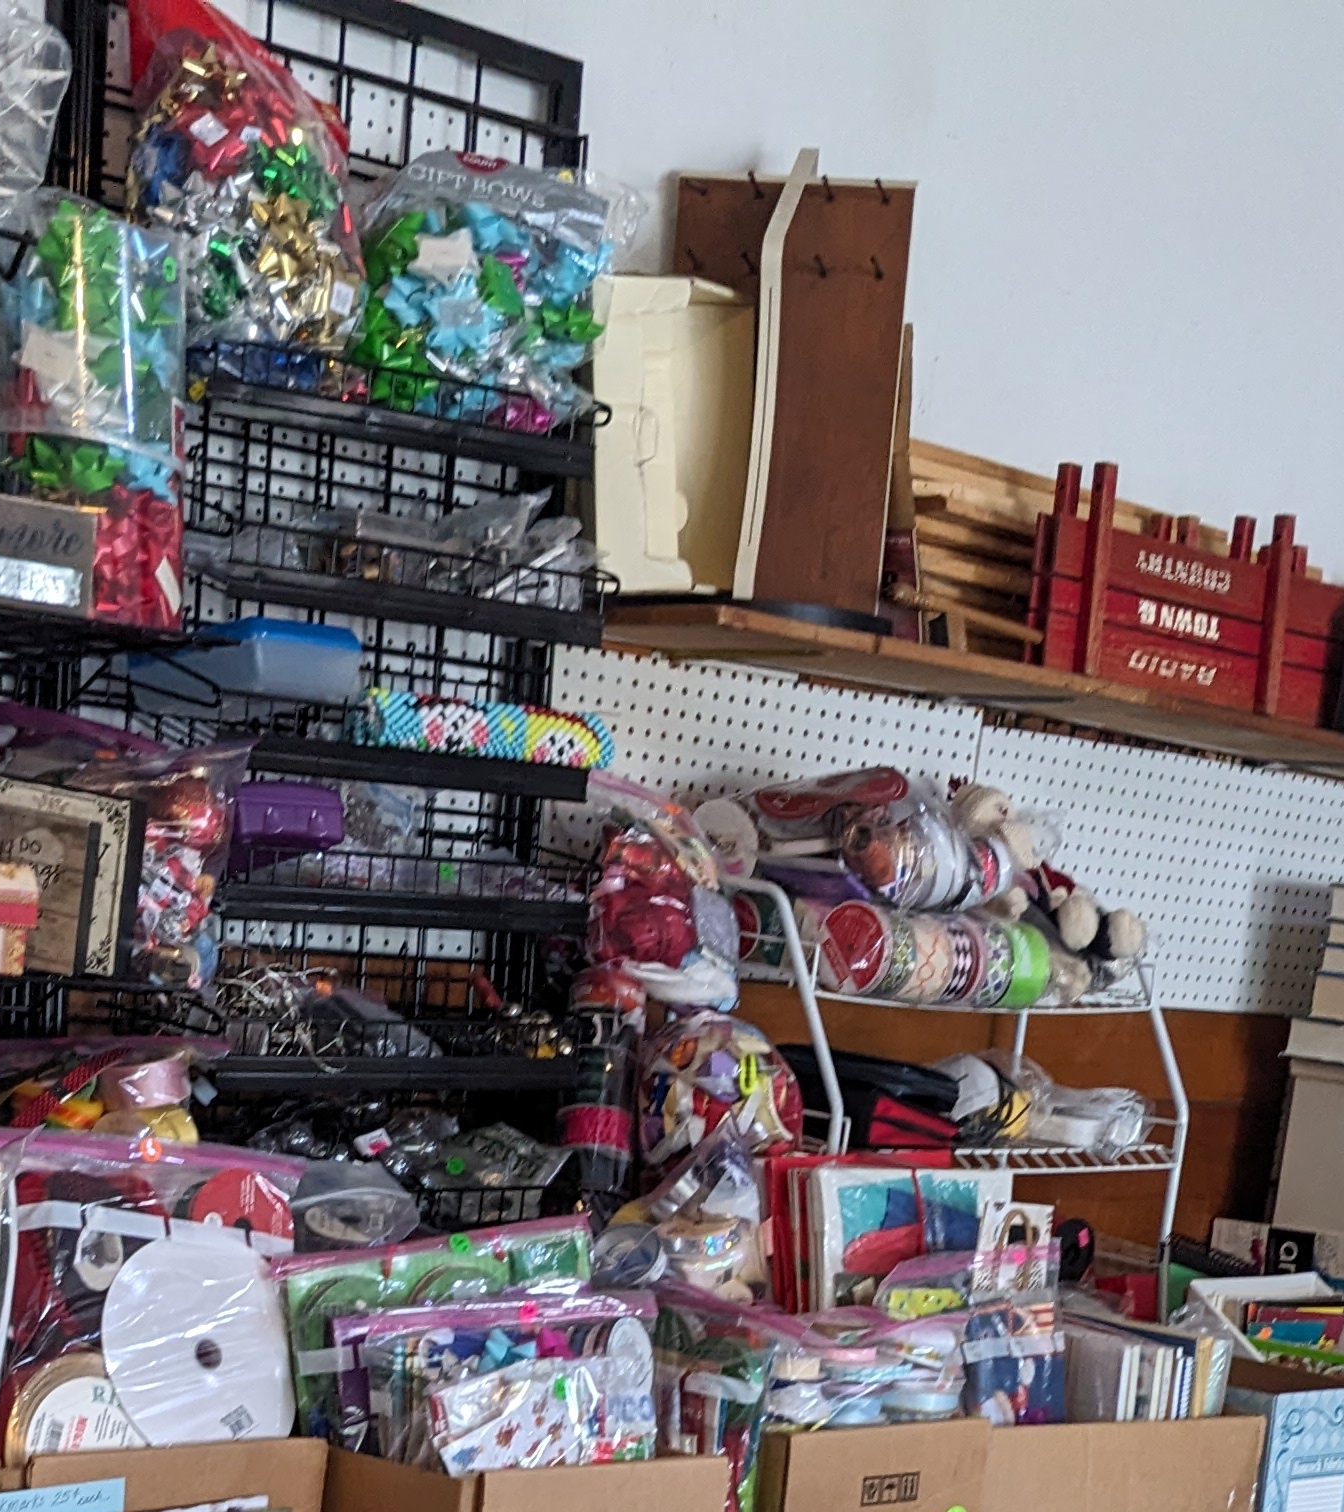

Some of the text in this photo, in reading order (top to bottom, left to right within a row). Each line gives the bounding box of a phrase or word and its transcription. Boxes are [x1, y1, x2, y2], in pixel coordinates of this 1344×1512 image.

[408, 163, 546, 209] GIFT BOWS
[1136, 550, 1232, 594] COUNTRY
[1158, 604, 1221, 642] TOWN
[1127, 649, 1218, 686] RADIO
